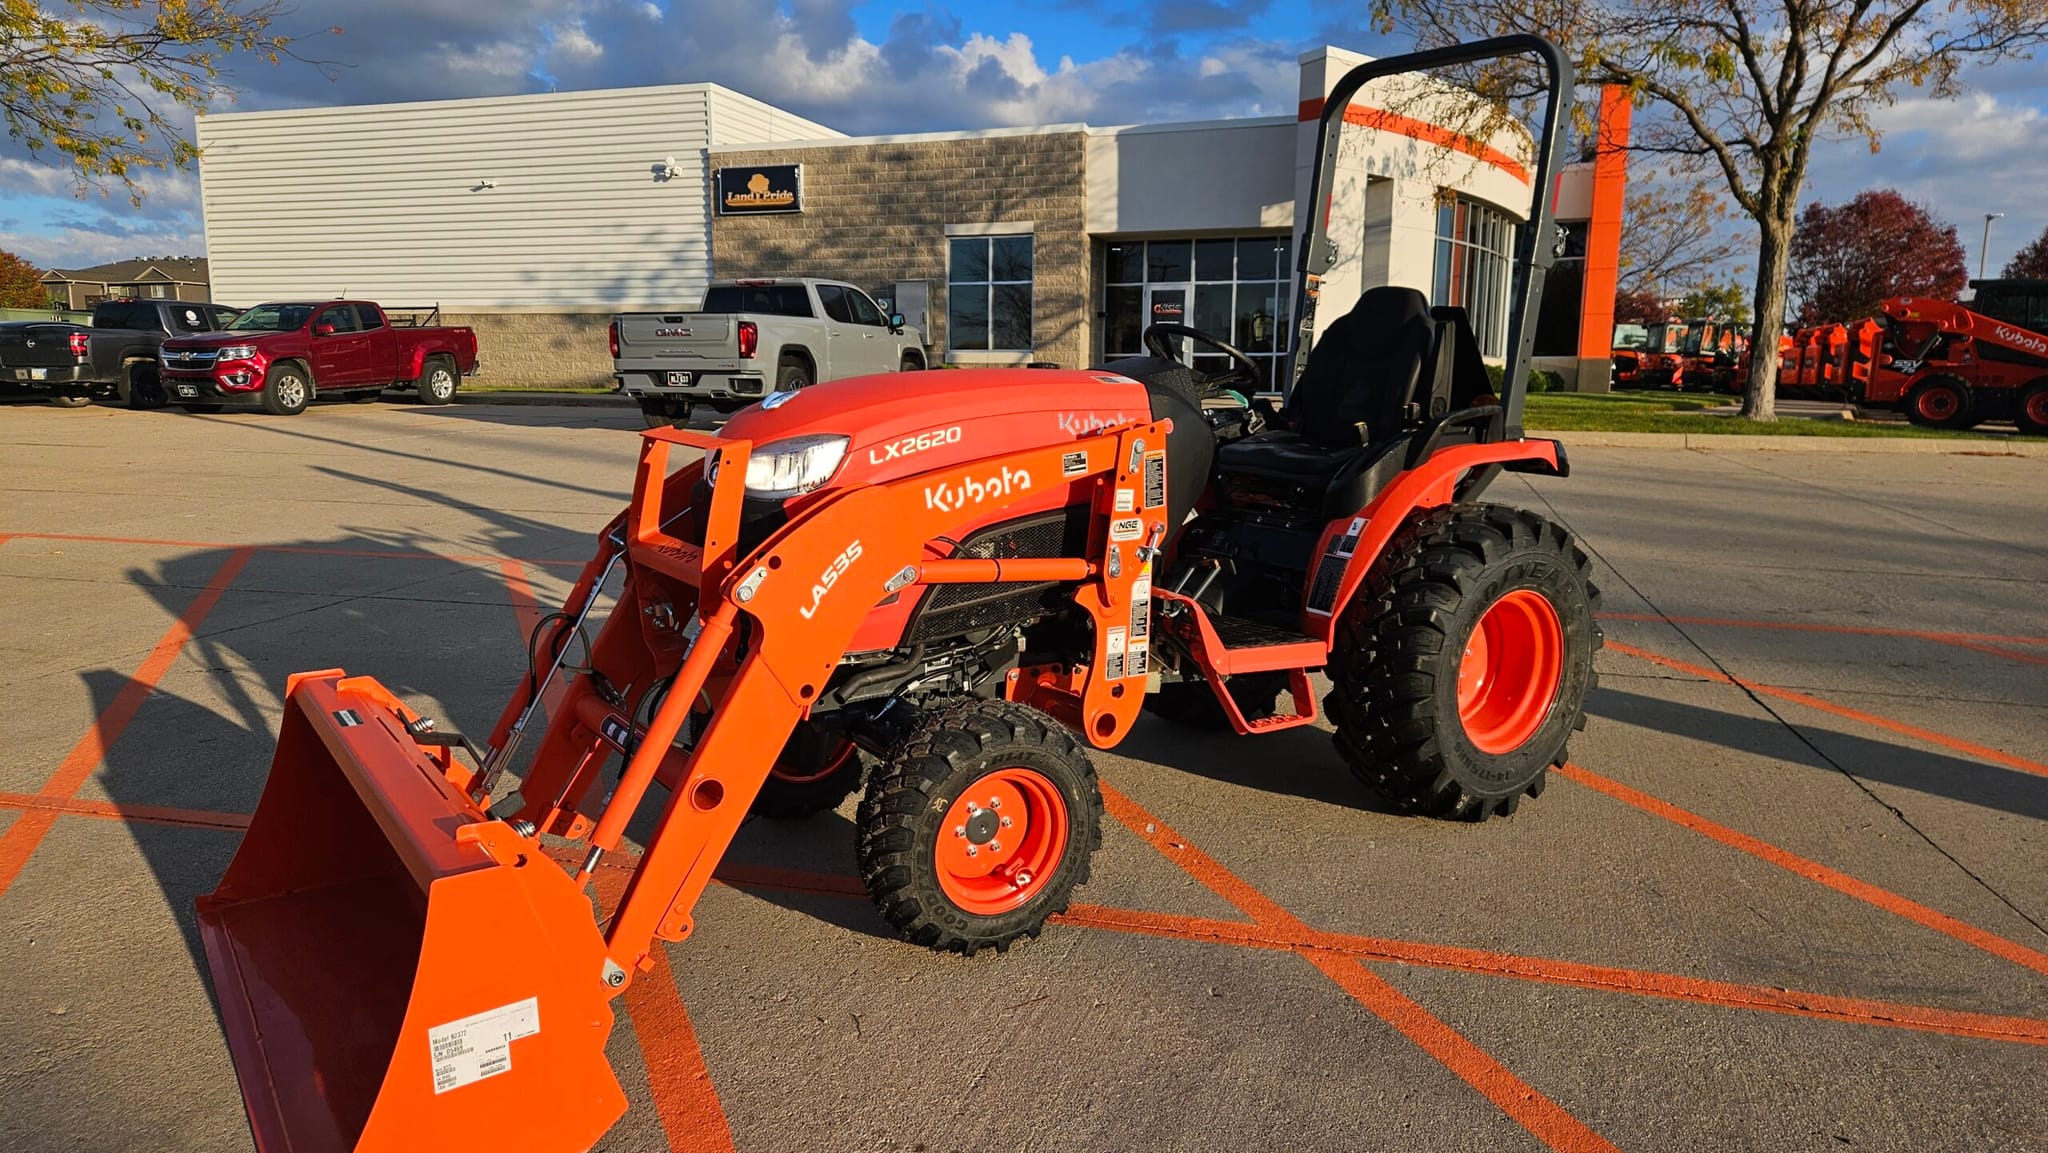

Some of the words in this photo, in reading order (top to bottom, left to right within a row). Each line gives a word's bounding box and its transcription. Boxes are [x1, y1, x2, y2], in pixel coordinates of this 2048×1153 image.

[727, 191, 755, 201] Land
[763, 189, 794, 200] Pride
[655, 328, 694, 337] GMC
[1995, 325, 2048, 353] Kubota
[1893, 359, 1923, 368] SSV
[869, 426, 962, 465] LX2620
[925, 466, 1031, 512] Kubota
[800, 539, 863, 619] LA535
[503, 1031, 512, 1042] 11
